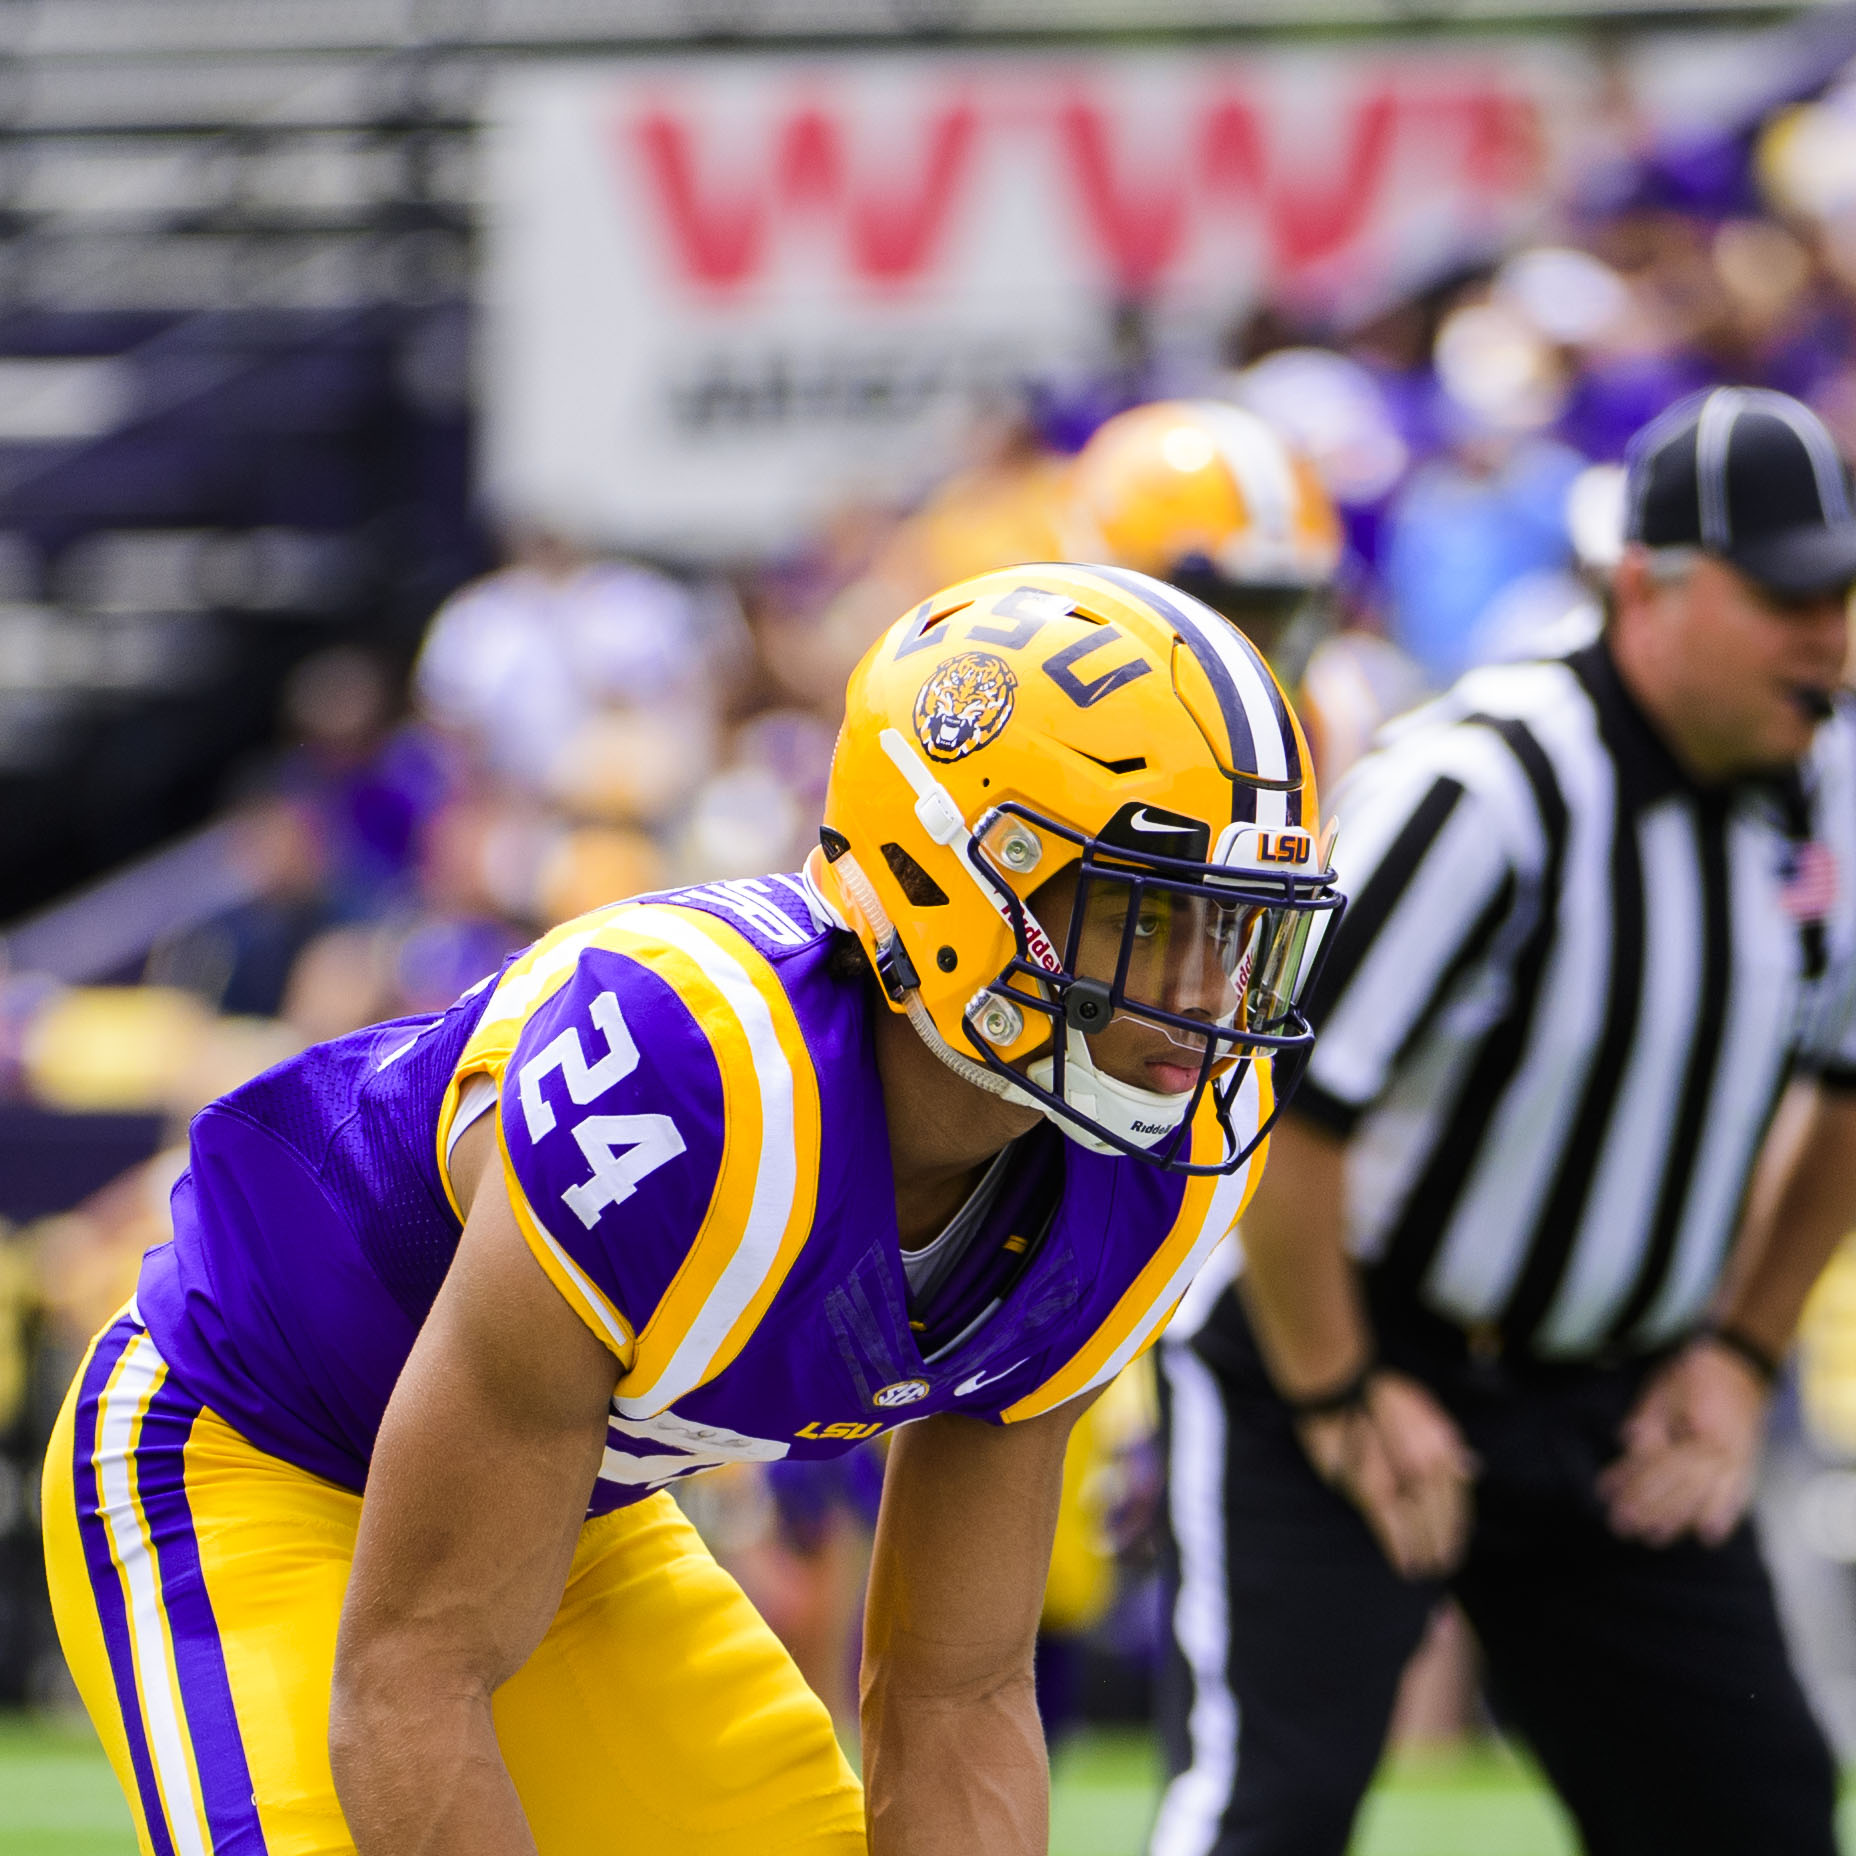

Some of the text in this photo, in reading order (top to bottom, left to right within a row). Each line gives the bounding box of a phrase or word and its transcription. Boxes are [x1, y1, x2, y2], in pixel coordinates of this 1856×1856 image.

[892, 583, 1152, 708] LSU
[1256, 832, 1311, 865] LSU
[518, 991, 687, 1231] 24
[793, 1421, 884, 1440] LSU
